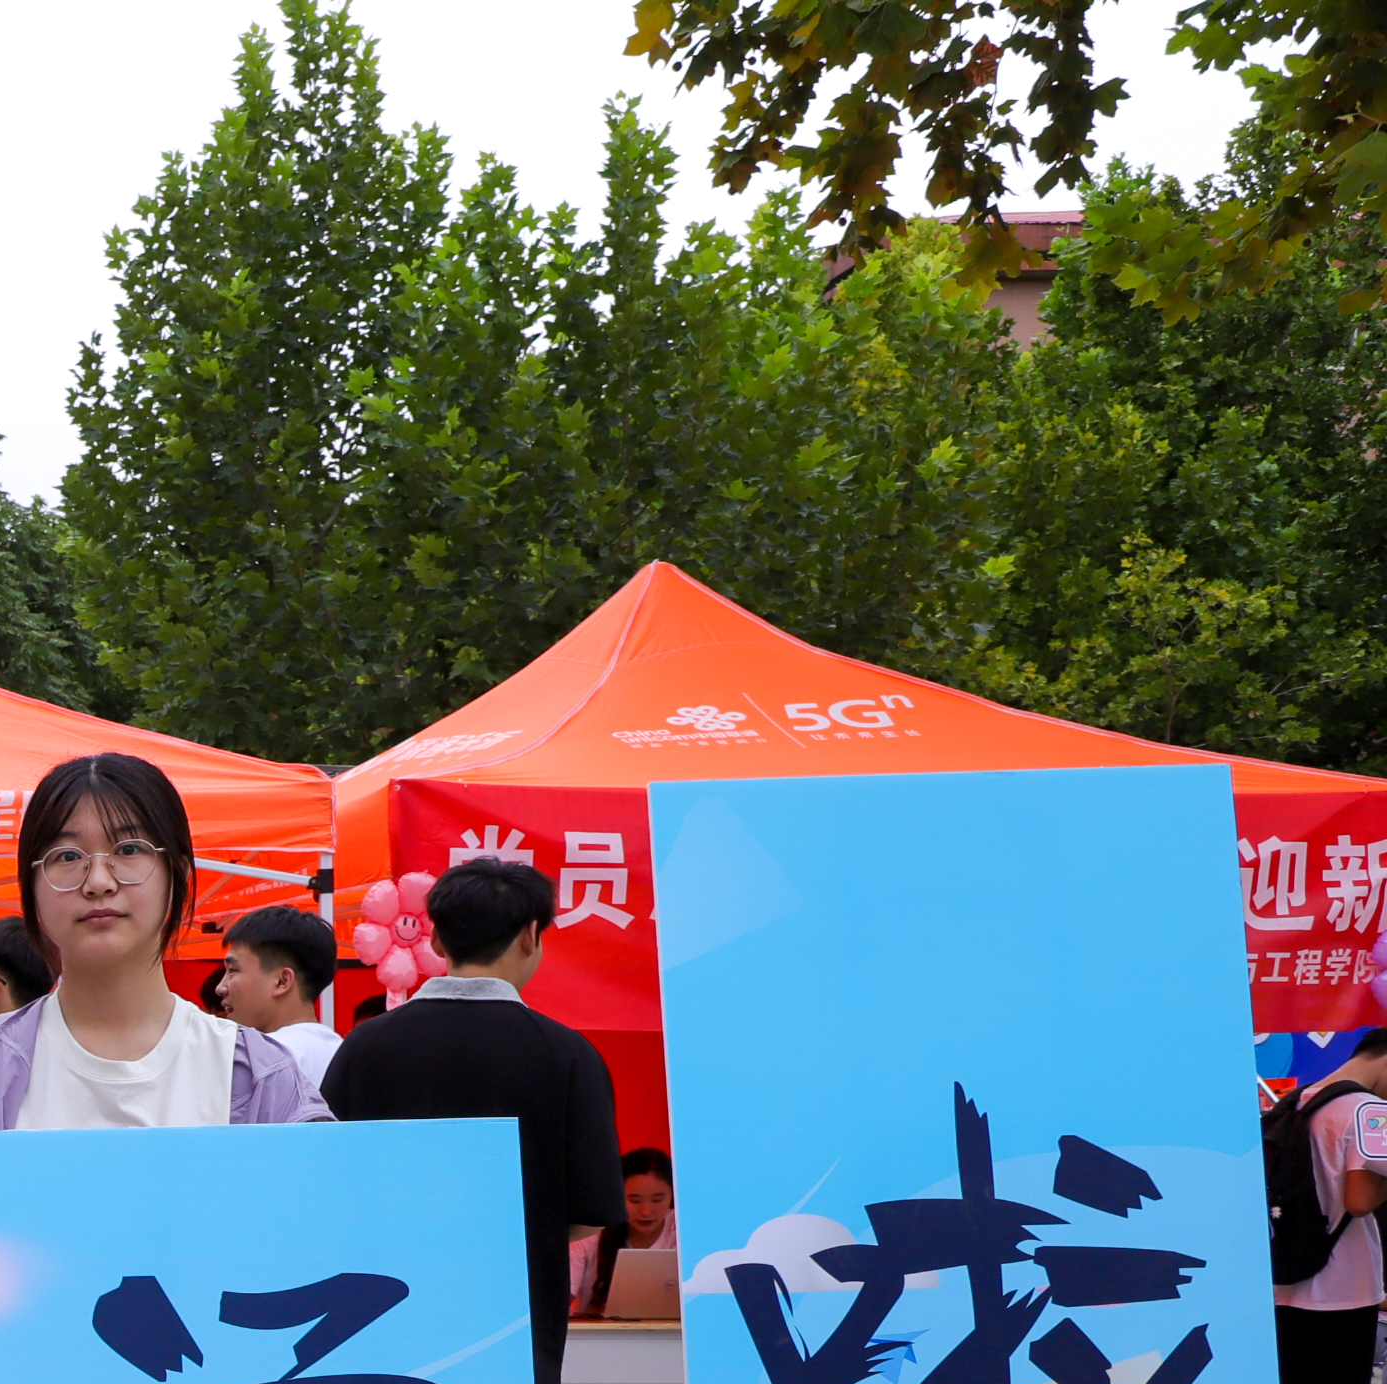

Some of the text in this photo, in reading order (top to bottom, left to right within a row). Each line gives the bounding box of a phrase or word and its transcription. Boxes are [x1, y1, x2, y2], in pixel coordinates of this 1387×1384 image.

[611, 729, 671, 739] China
[621, 729, 760, 743] unicom 中国联通
[1238, 835, 1387, 934] 迎新
